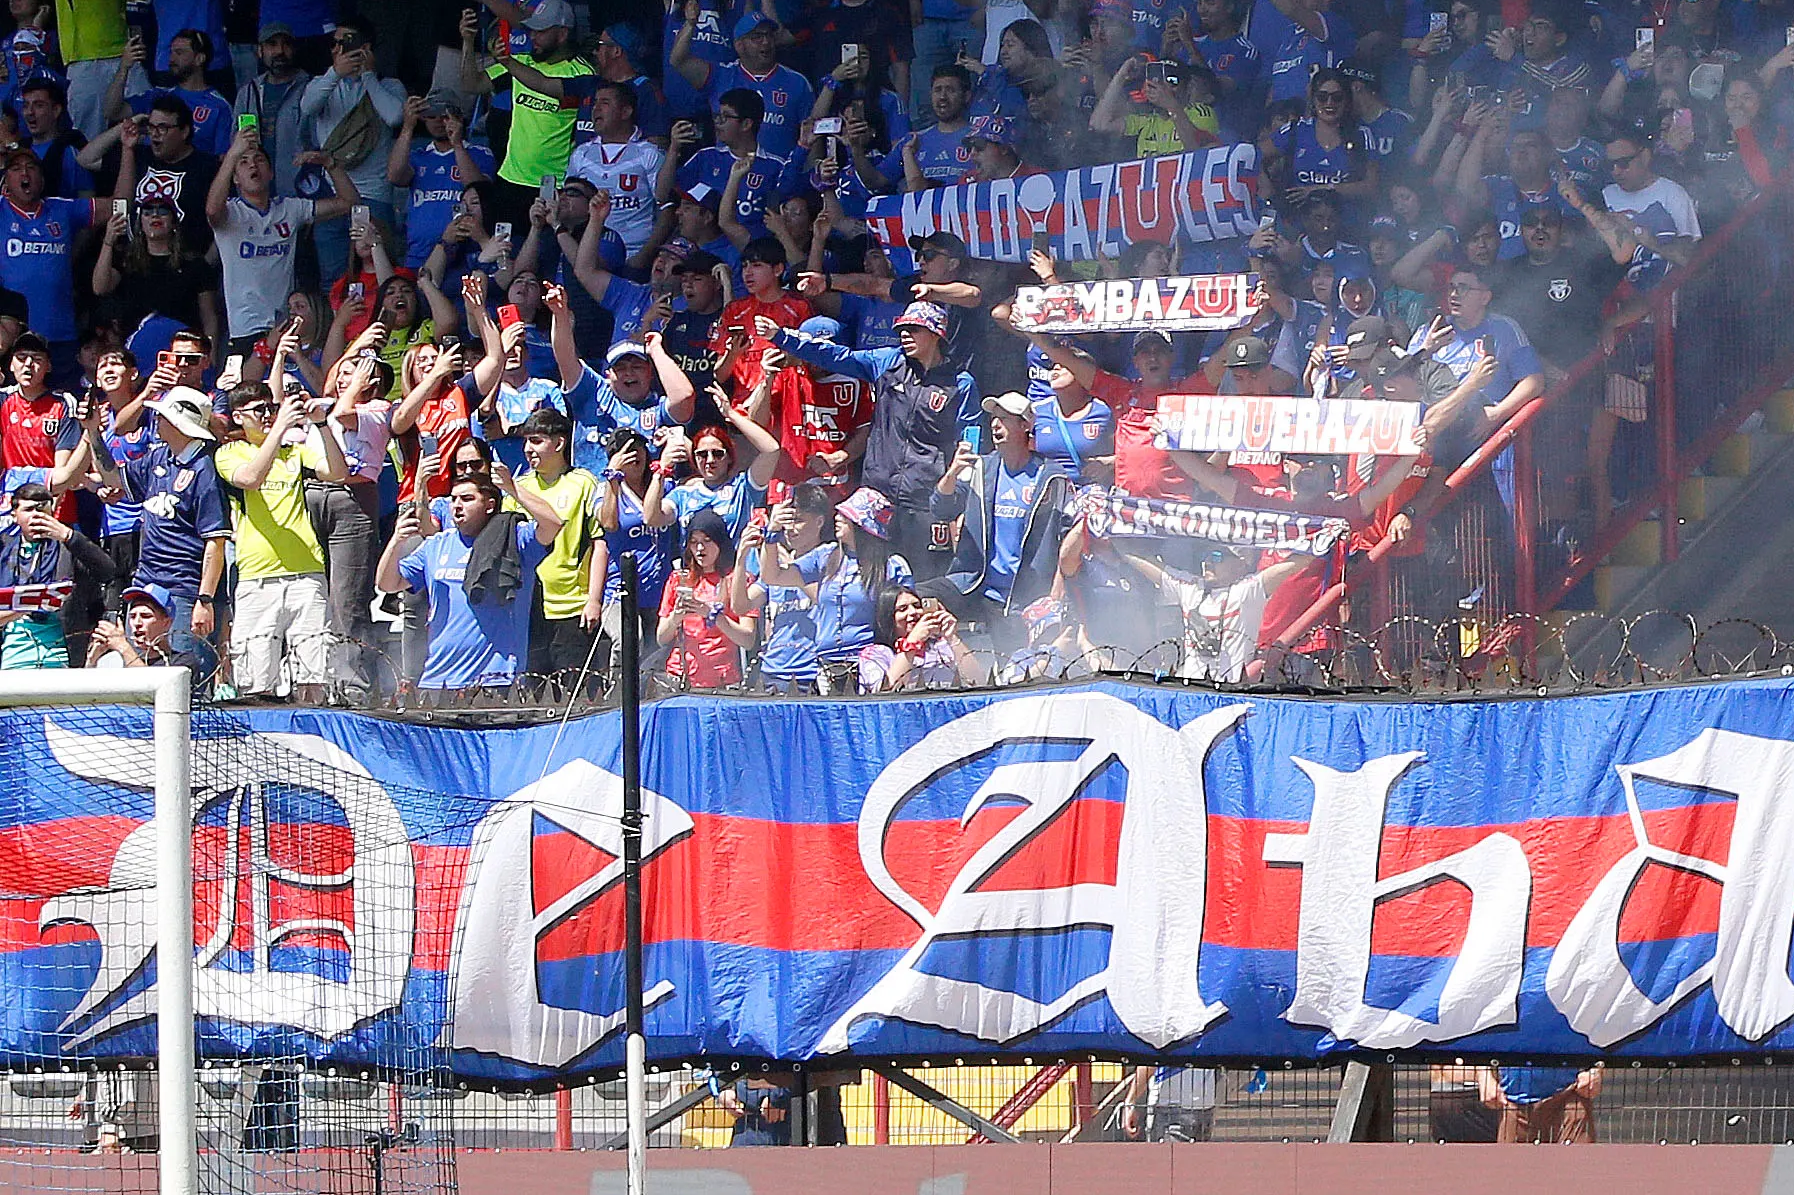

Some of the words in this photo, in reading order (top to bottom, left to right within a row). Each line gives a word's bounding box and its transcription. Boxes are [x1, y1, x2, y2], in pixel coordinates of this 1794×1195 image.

[673, 28, 730, 47] TLMEX
[1297, 168, 1341, 185] Claro
[1018, 274, 1256, 326] BMBAZUL
[1111, 499, 1156, 535] LA
